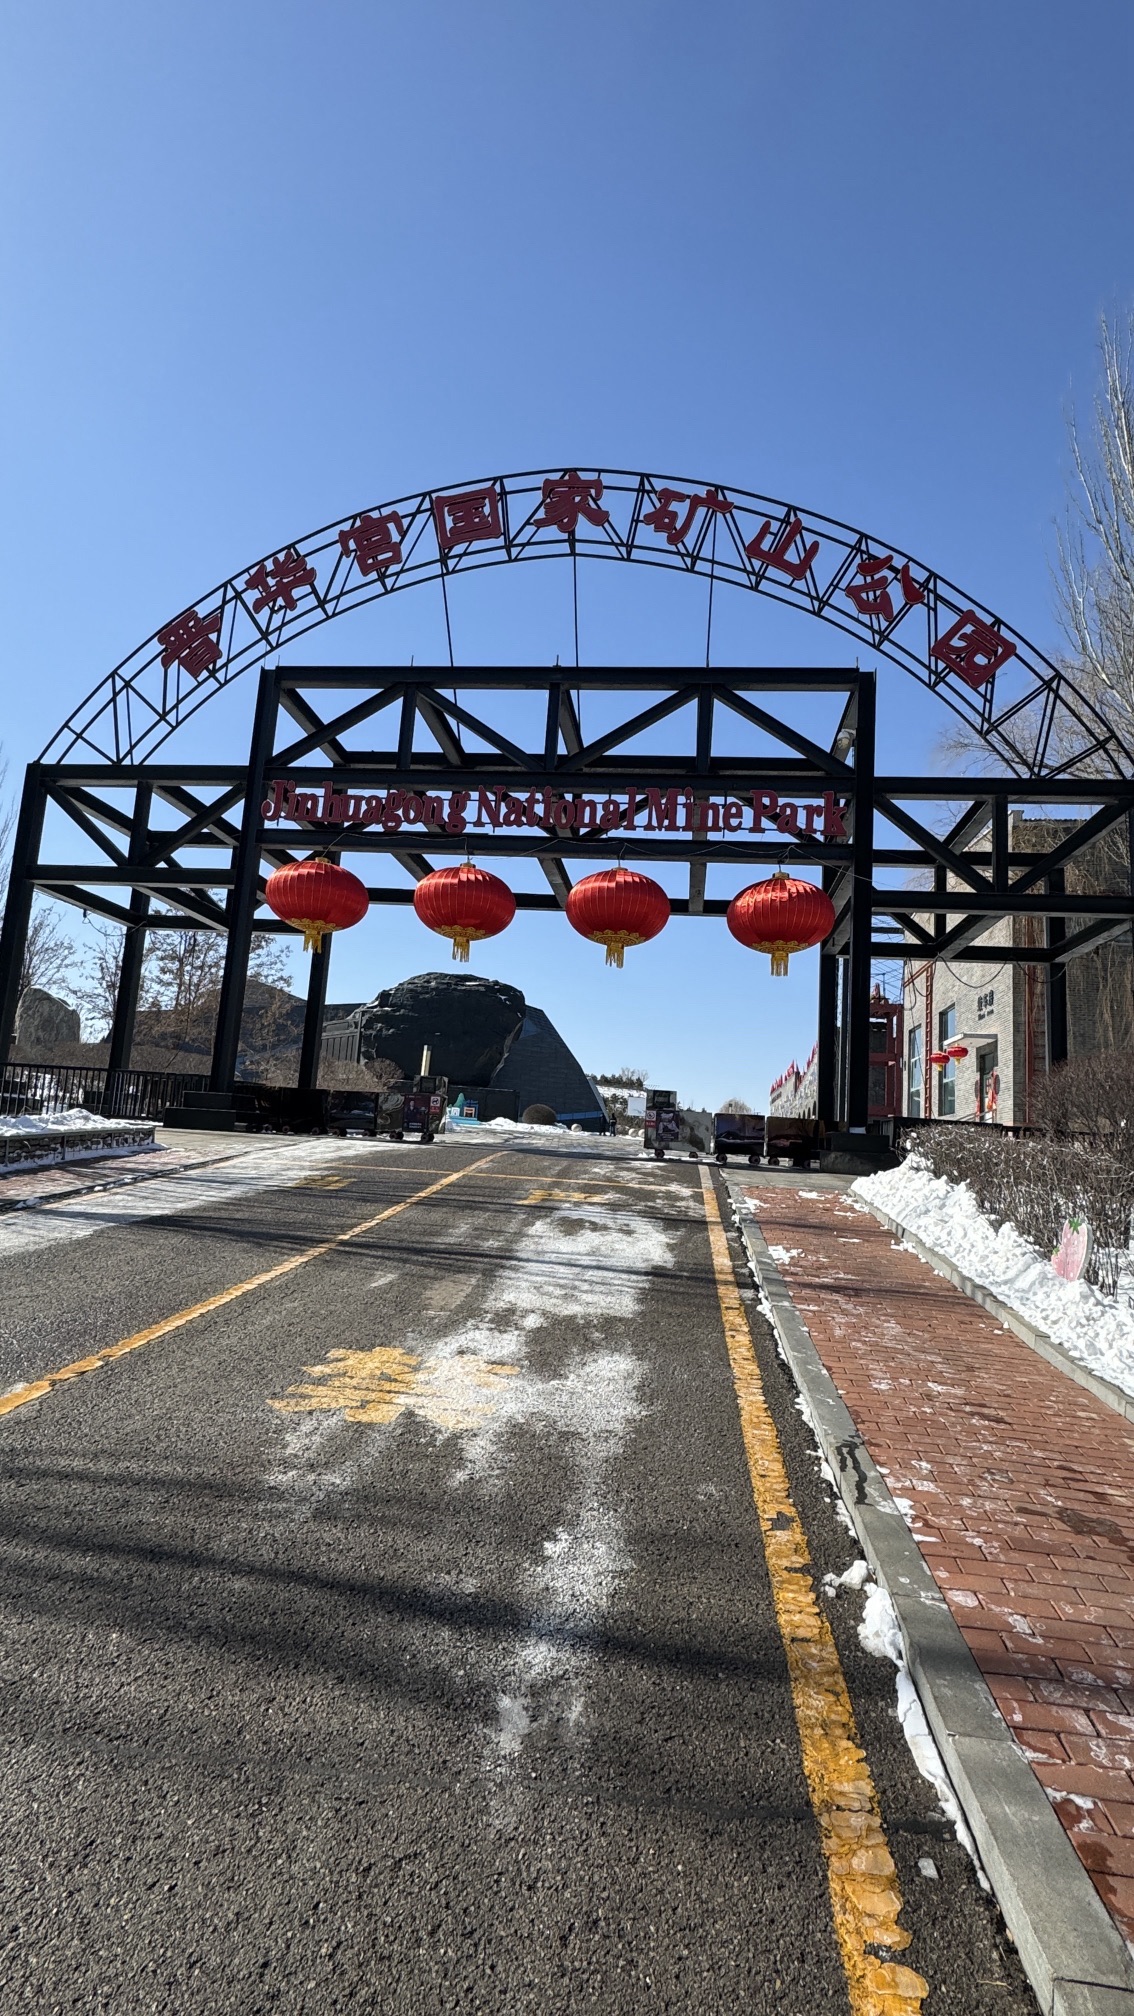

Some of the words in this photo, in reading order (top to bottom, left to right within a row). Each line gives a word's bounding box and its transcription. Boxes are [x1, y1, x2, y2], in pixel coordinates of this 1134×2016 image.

[157, 471, 1017, 688] 晋华宫国家矿山公园
[261, 779, 472, 834] Jinhuagong
[474, 785, 640, 831] National
[644, 786, 743, 834] Mine
[750, 789, 849, 837] Park
